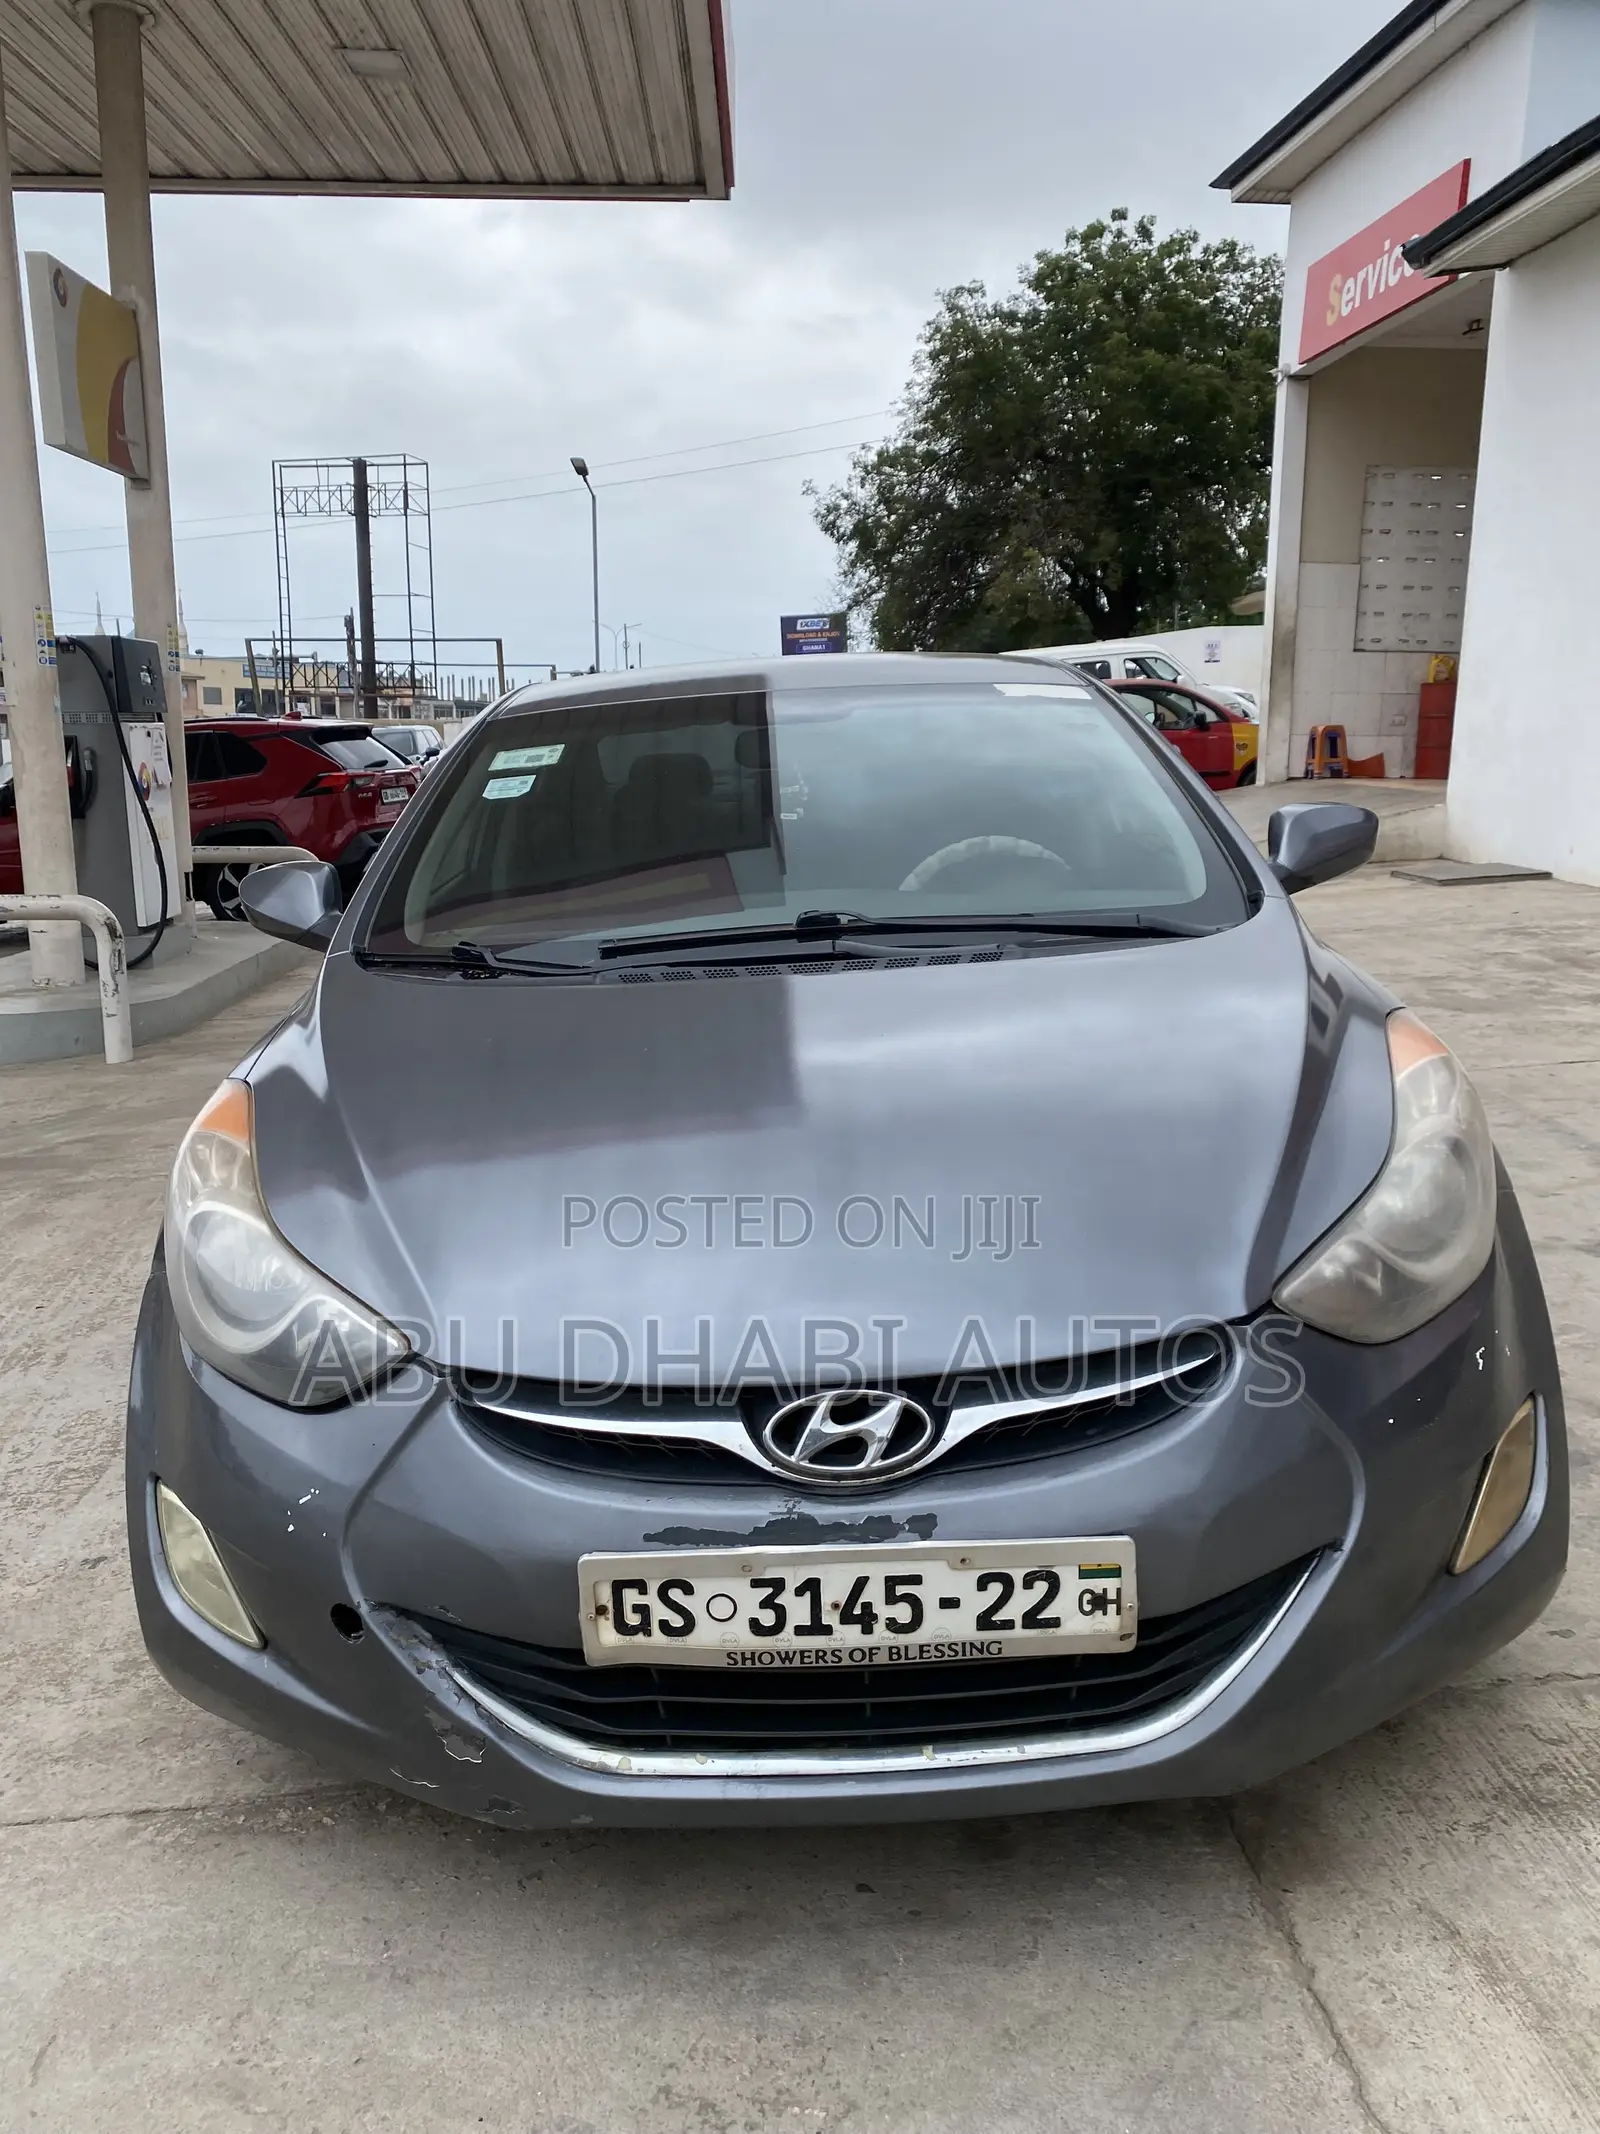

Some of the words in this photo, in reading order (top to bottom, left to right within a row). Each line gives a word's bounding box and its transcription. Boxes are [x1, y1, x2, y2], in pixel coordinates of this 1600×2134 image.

[612, 1578, 696, 1637] GS
[748, 1569, 1061, 1637] 3145-22
[1078, 1588, 1121, 1617] GH
[726, 1650, 843, 1666] SHOWERS
[848, 1648, 881, 1664] OF
[888, 1640, 1003, 1662] BLESSING
